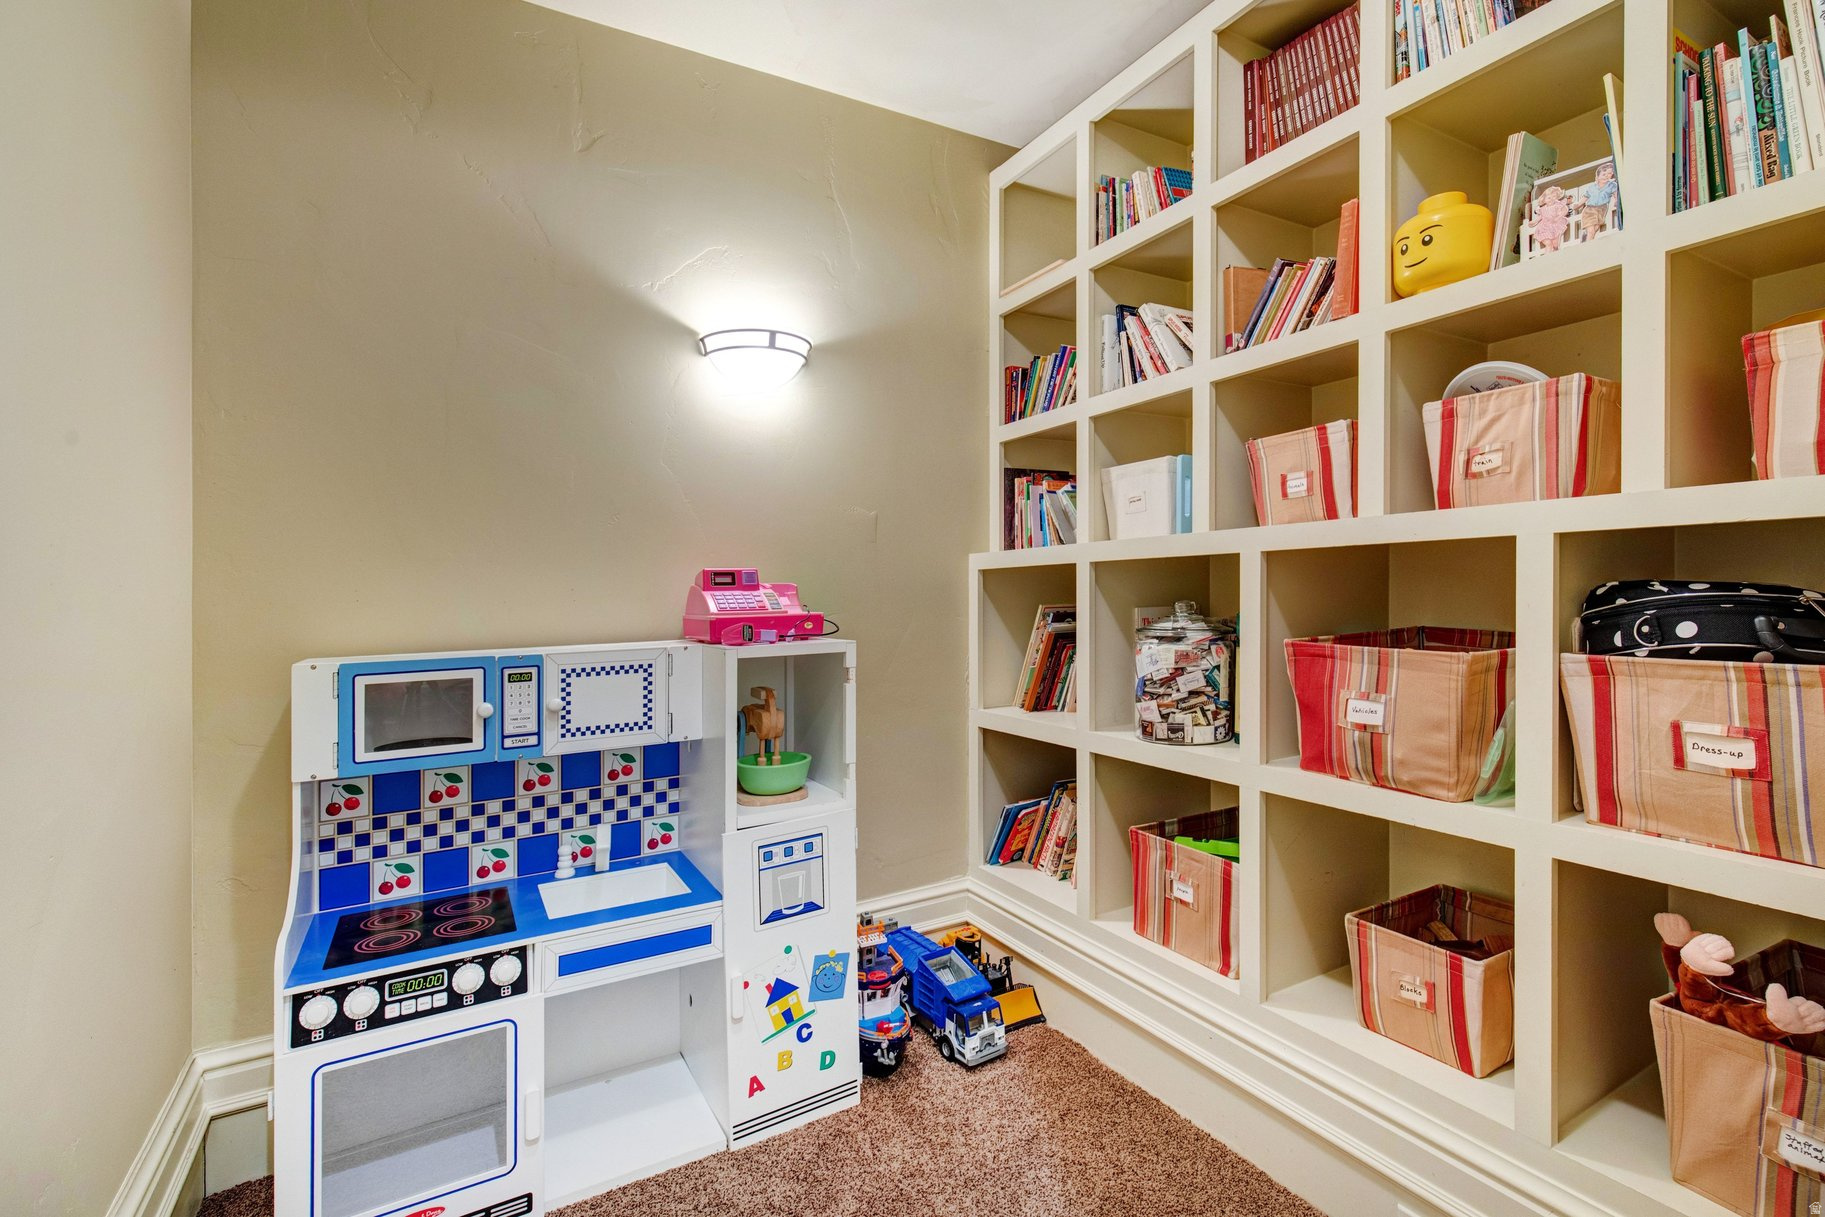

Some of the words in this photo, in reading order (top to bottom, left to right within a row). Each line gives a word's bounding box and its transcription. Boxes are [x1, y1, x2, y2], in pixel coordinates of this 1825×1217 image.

[1702, 55, 1712, 85] TALKING
[1802, 70, 1812, 86] Book
[1705, 85, 1713, 97] TO
[1705, 97, 1715, 112] THE
[1707, 112, 1717, 128] SUN
[1763, 133, 1775, 160] Mixed
[1766, 159, 1778, 179] Bag
[1691, 742, 1743, 759] Dress-up
[407, 974, 443, 992] 00:00
[796, 1022, 813, 1043] C
[777, 1050, 793, 1072] B
[819, 1050, 836, 1071] D
[748, 1075, 765, 1099] A
